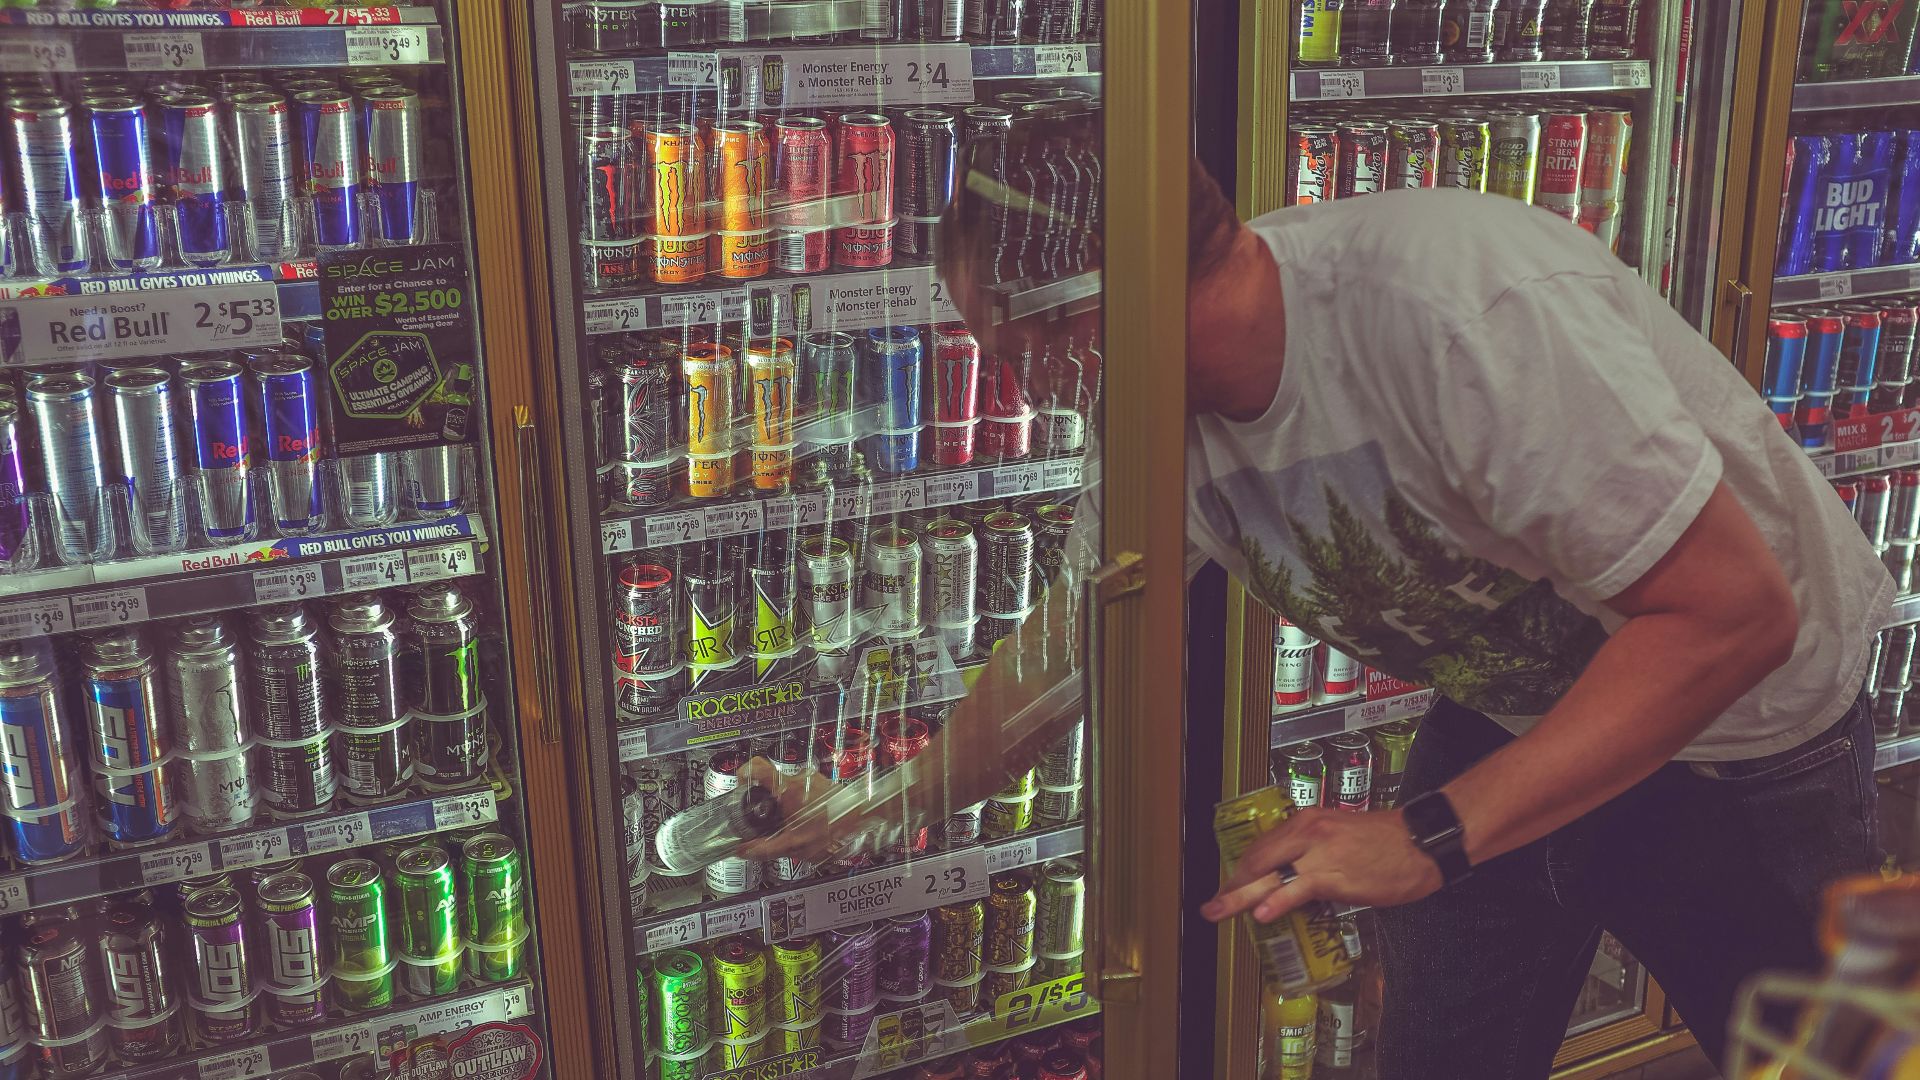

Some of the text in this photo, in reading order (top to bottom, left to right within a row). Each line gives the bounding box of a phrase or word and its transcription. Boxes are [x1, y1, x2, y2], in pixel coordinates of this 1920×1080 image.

[26, 13, 54, 26] RED
[57, 13, 91, 26] BULL
[91, 12, 132, 26] GIVES
[135, 12, 163, 26] YOU
[245, 14, 301, 26] Red Bull
[802, 61, 888, 75] Monster Energy
[907, 62, 920, 83] 2
[798, 75, 893, 88] & Monster Rehab
[1548, 138, 1580, 148] STRAW
[1545, 156, 1577, 171] RITA
[1826, 178, 1874, 207] BUD
[1815, 202, 1880, 232] LIGHT
[327, 256, 455, 278] SPACE JAM
[80, 269, 263, 295] RED BULL GIVES YOU WIIINGS.
[337, 284, 366, 294] Enter
[367, 282, 382, 291] for
[394, 279, 432, 289] Chance
[435, 278, 447, 286] to
[829, 283, 912, 300] Monster Energy
[930, 282, 943, 302] 2
[69, 303, 146, 317] Need a Boost?
[326, 287, 462, 321] OVER $2,500
[331, 294, 365, 308] WIN
[826, 297, 917, 314] & Monster Rehab
[193, 302, 214, 329] 2
[395, 316, 416, 325] Worth
[402, 320, 454, 331] Camping Gear
[50, 311, 168, 345] Red Bull
[339, 340, 421, 379] SPACE JAM
[349, 366, 429, 401] ULTIMATE CAMPING
[351, 393, 397, 411] ESSENTIALS
[397, 375, 433, 402] GIVEAWAY
[1837, 425, 1858, 437] MIX
[1881, 415, 1894, 442] 2
[211, 435, 248, 459] Red
[299, 523, 461, 556] RED BULL GIVES YOU WIIINGS.
[181, 552, 239, 572] Red Bull
[687, 682, 804, 720] ROCKSTAR
[485, 877, 522, 901] AMP
[826, 877, 903, 904] ROCKSTAR
[924, 874, 937, 894] 2
[839, 890, 893, 915] ENERGY
[330, 912, 377, 930] AMP
[60, 951, 87, 973] NOS
[418, 1000, 486, 1024] AMP ENERGY
[452, 1045, 528, 1078] OUTLAW
